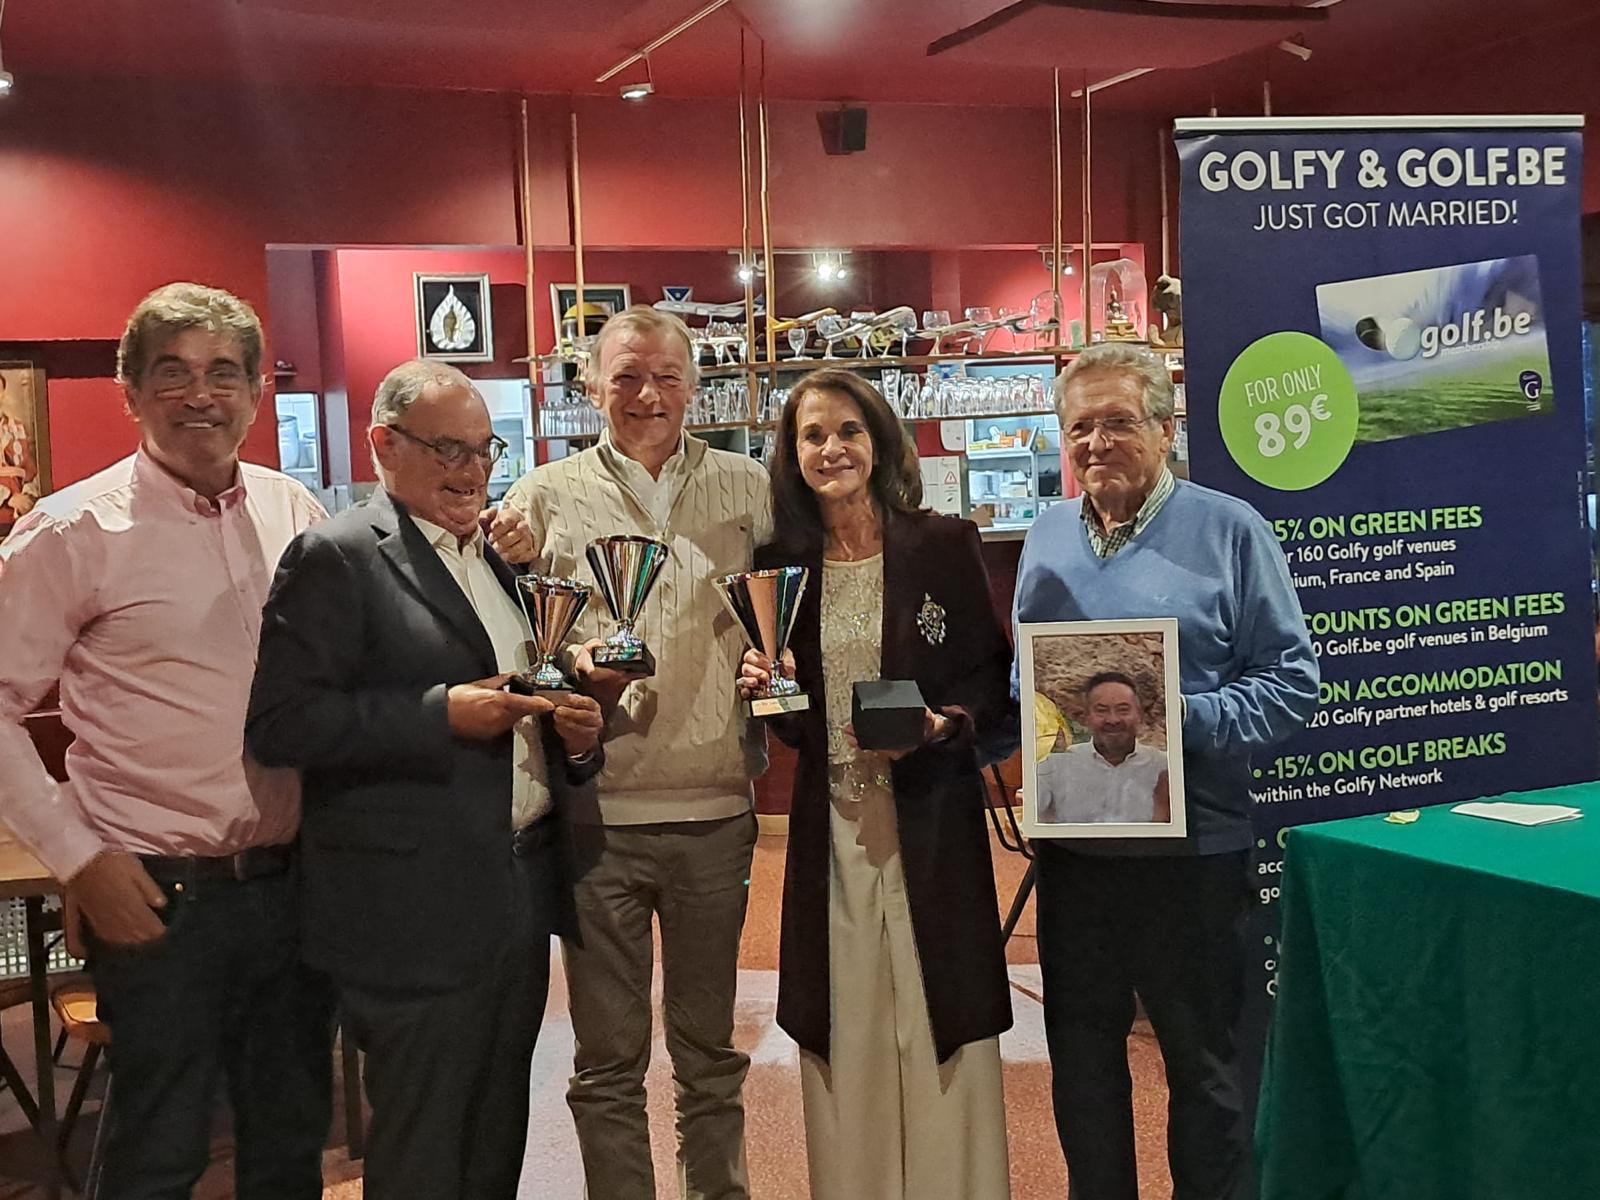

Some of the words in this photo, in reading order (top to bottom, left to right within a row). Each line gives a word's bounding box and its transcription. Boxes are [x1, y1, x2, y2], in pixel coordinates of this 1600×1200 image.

[1199, 149, 1345, 192] GOLFY
[1357, 149, 1388, 188] &
[1397, 147, 1567, 188] GOLF.BE
[1253, 204, 1317, 231] JUST
[1323, 202, 1381, 229] GOT
[1388, 199, 1519, 227] MARRIED!
[1421, 307, 1531, 358] golf.be
[1245, 375, 1278, 407] FOR
[1282, 364, 1322, 399] ONLY
[1254, 394, 1332, 457] 89€
[1309, 515, 1345, 539] ON
[1350, 509, 1426, 537] GREEN
[1431, 505, 1483, 530] FEES
[1297, 545, 1324, 562] 160
[1327, 542, 1370, 563] Golfy
[1373, 538, 1403, 561] golf
[1406, 538, 1457, 554] venues
[1293, 572, 1327, 589] ium,
[1329, 568, 1381, 584] France
[1384, 564, 1412, 581] and
[1415, 561, 1455, 583] Spain
[1396, 603, 1430, 629] ON
[1435, 597, 1509, 624] GREEN
[1514, 592, 1566, 616] FEES
[1326, 637, 1382, 656] Golf.be
[1386, 633, 1416, 655] golf
[1418, 631, 1468, 647] venues
[1471, 627, 1485, 642] in
[1488, 623, 1548, 644] Belgium
[1318, 680, 1351, 705] ON
[1355, 659, 1562, 701] ACCOMMODATION
[1306, 710, 1329, 729] 20
[1333, 706, 1373, 727] Golfy
[1376, 704, 1428, 726] partner
[1430, 696, 1472, 716] hotels
[1475, 695, 1486, 710] &
[1488, 691, 1517, 712] golf
[1520, 688, 1568, 704] resorts
[1318, 750, 1355, 774] ON
[1359, 742, 1419, 768] GOLF
[1424, 732, 1507, 762] BREAKS
[1253, 785, 1302, 804] within
[1306, 782, 1330, 799] the
[1334, 776, 1376, 799] Golfy
[1379, 768, 1443, 790] Network
